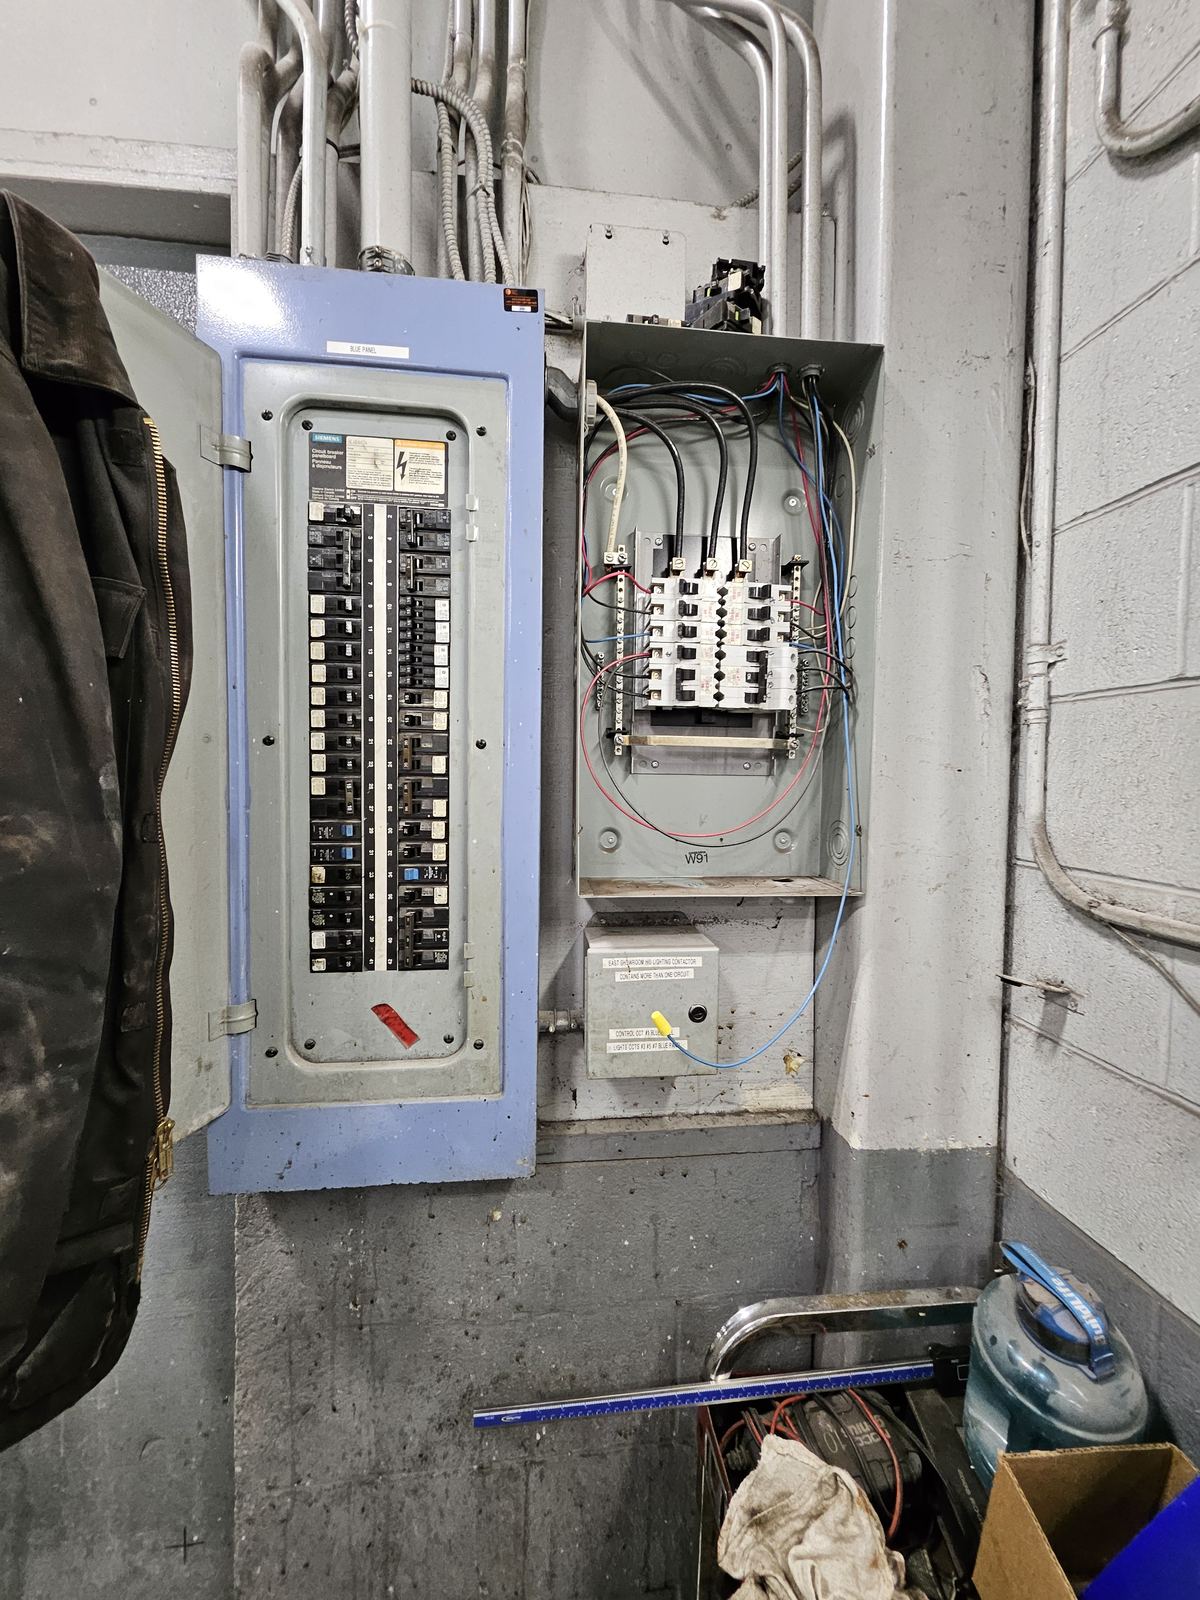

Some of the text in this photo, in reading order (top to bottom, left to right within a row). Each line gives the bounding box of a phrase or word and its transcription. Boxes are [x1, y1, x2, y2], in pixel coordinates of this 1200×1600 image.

[350, 345, 376, 354] BLUE PANEL
[314, 434, 341, 442] SIEMENS
[672, 958, 696, 966] CONTACTOR
